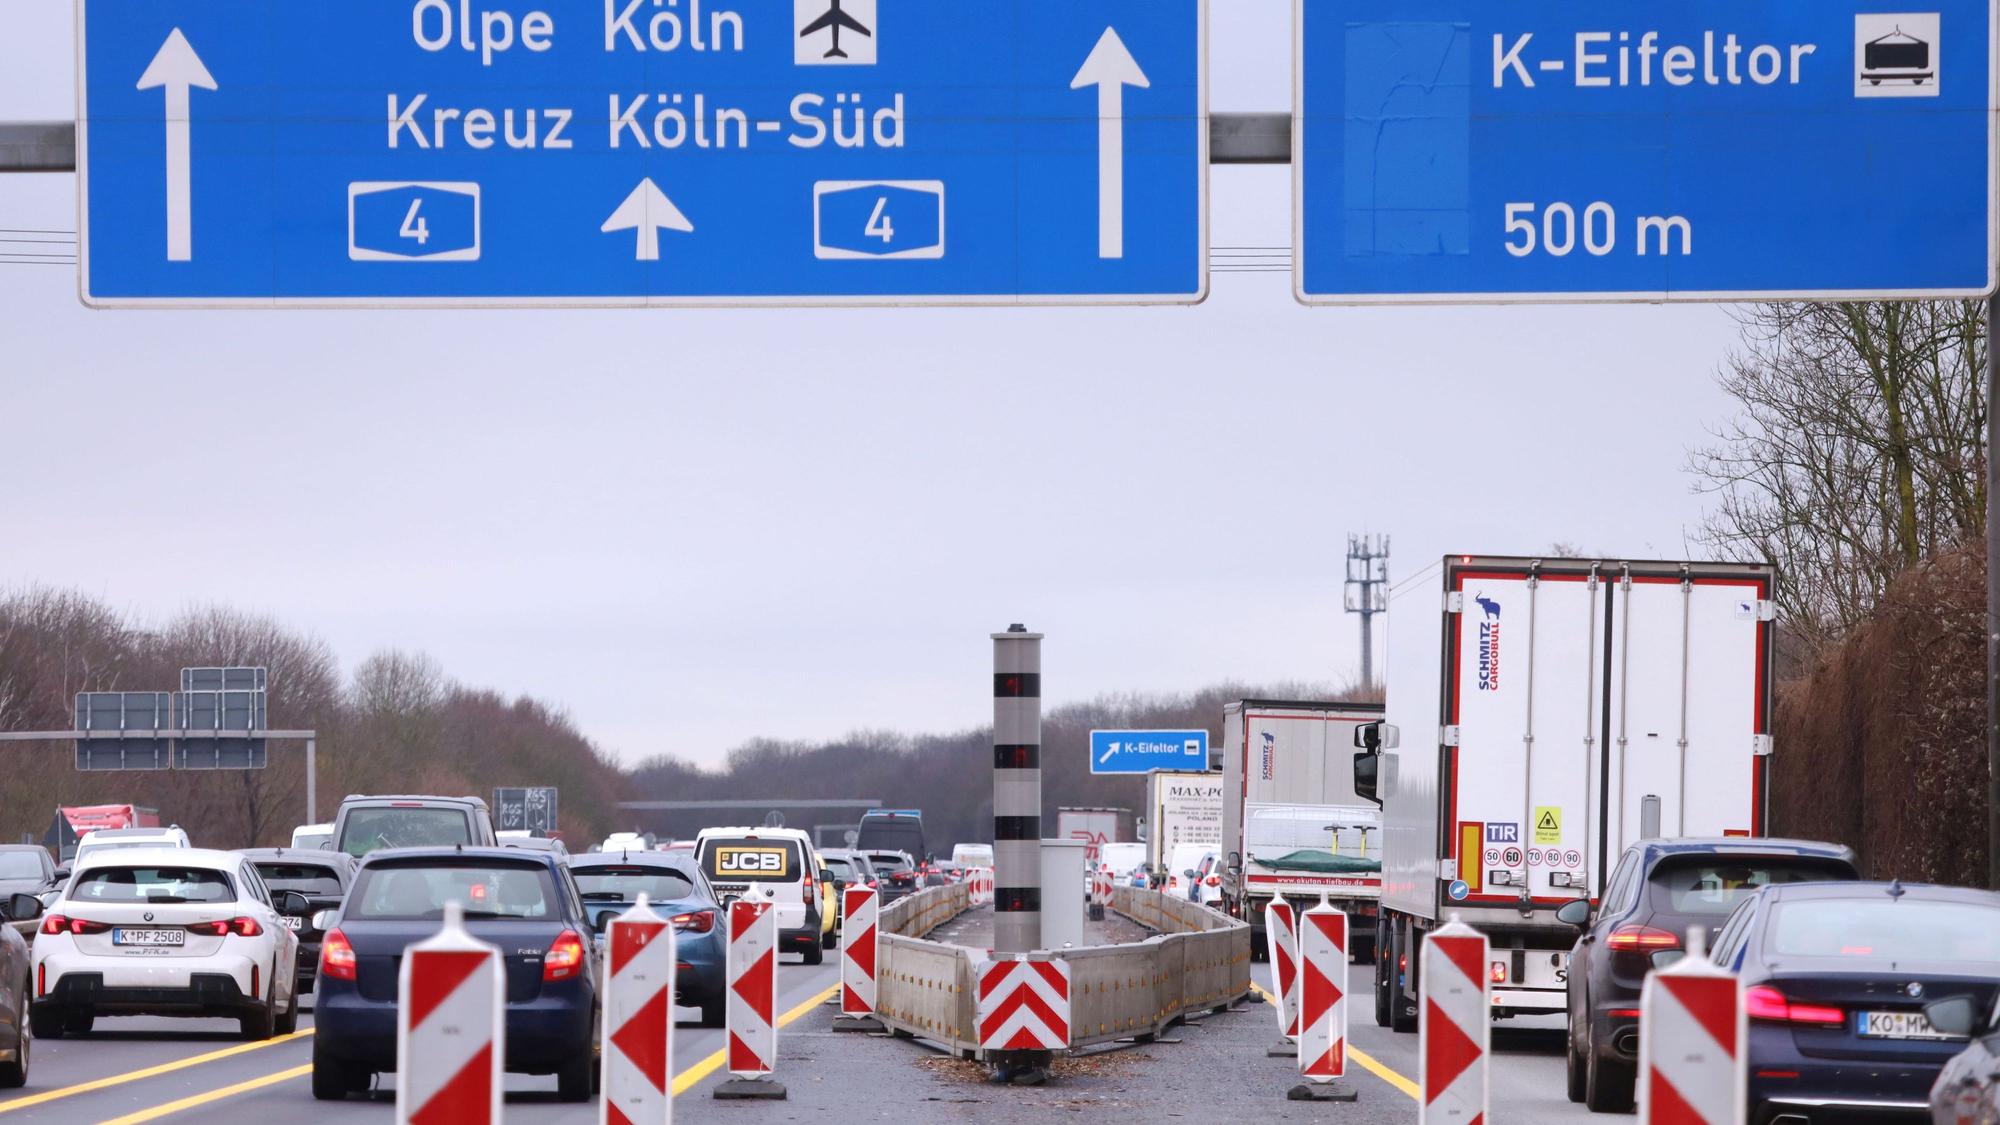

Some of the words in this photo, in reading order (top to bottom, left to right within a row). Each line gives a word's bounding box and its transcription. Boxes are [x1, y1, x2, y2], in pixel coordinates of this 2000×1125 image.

[412, 0, 554, 66] Olpe
[604, 0, 743, 51] Köln
[1492, 31, 1817, 88] K-Eifeltor
[387, 94, 573, 149] Kreuz
[609, 93, 904, 148] Köln-Süd
[399, 199, 429, 244] 4
[864, 197, 894, 242] 4
[1505, 201, 1616, 257] 500
[1637, 215, 1692, 256] m
[1479, 622, 1490, 690] SCHMITZ
[1490, 622, 1499, 690] CARGOBULL
[1124, 742, 1179, 754] K-Eifeltor
[1488, 825, 1516, 841] TIR
[721, 853, 780, 870] JCB
[1487, 851, 1498, 861] 50
[1505, 850, 1519, 862] 60
[1529, 852, 1540, 861] 70
[1547, 853, 1559, 862] 80
[1566, 854, 1578, 863] 90
[121, 931, 128, 942] K
[136, 931, 151, 942] PF
[154, 931, 182, 943] 2508
[1870, 1014, 1894, 1032] KO
